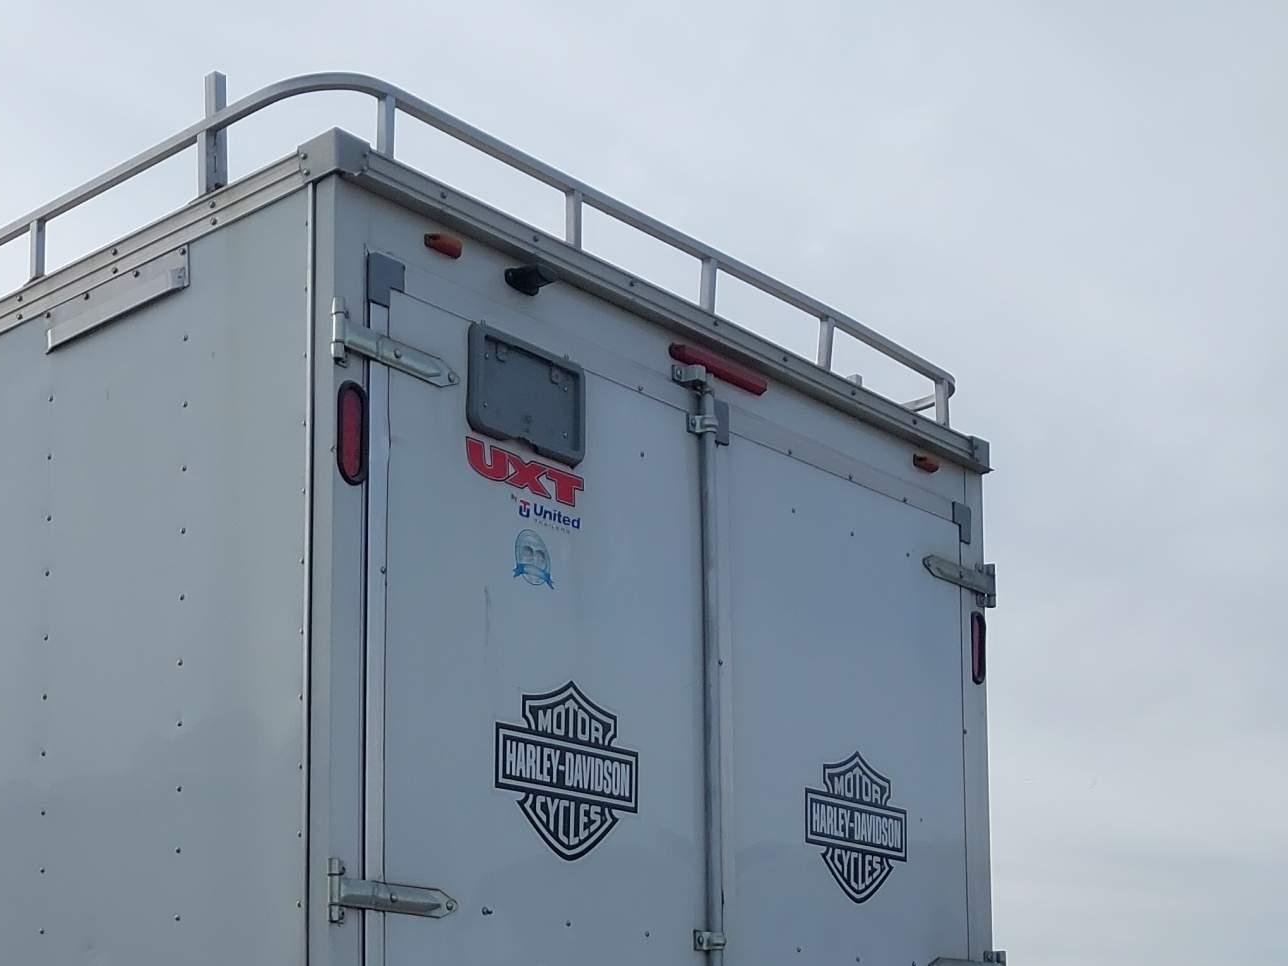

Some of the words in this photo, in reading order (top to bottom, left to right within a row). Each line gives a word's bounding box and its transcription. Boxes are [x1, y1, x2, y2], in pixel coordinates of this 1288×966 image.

[466, 436, 584, 507] UXT
[534, 503, 581, 529] United
[538, 699, 604, 745] MOTOR
[505, 739, 630, 798] HARLEY-DAVIDSON
[834, 766, 881, 805] MOTOR
[535, 794, 602, 846] CYCLES
[812, 801, 902, 849] HARLEY-DAVIDSON
[833, 847, 881, 891] CYCLES
